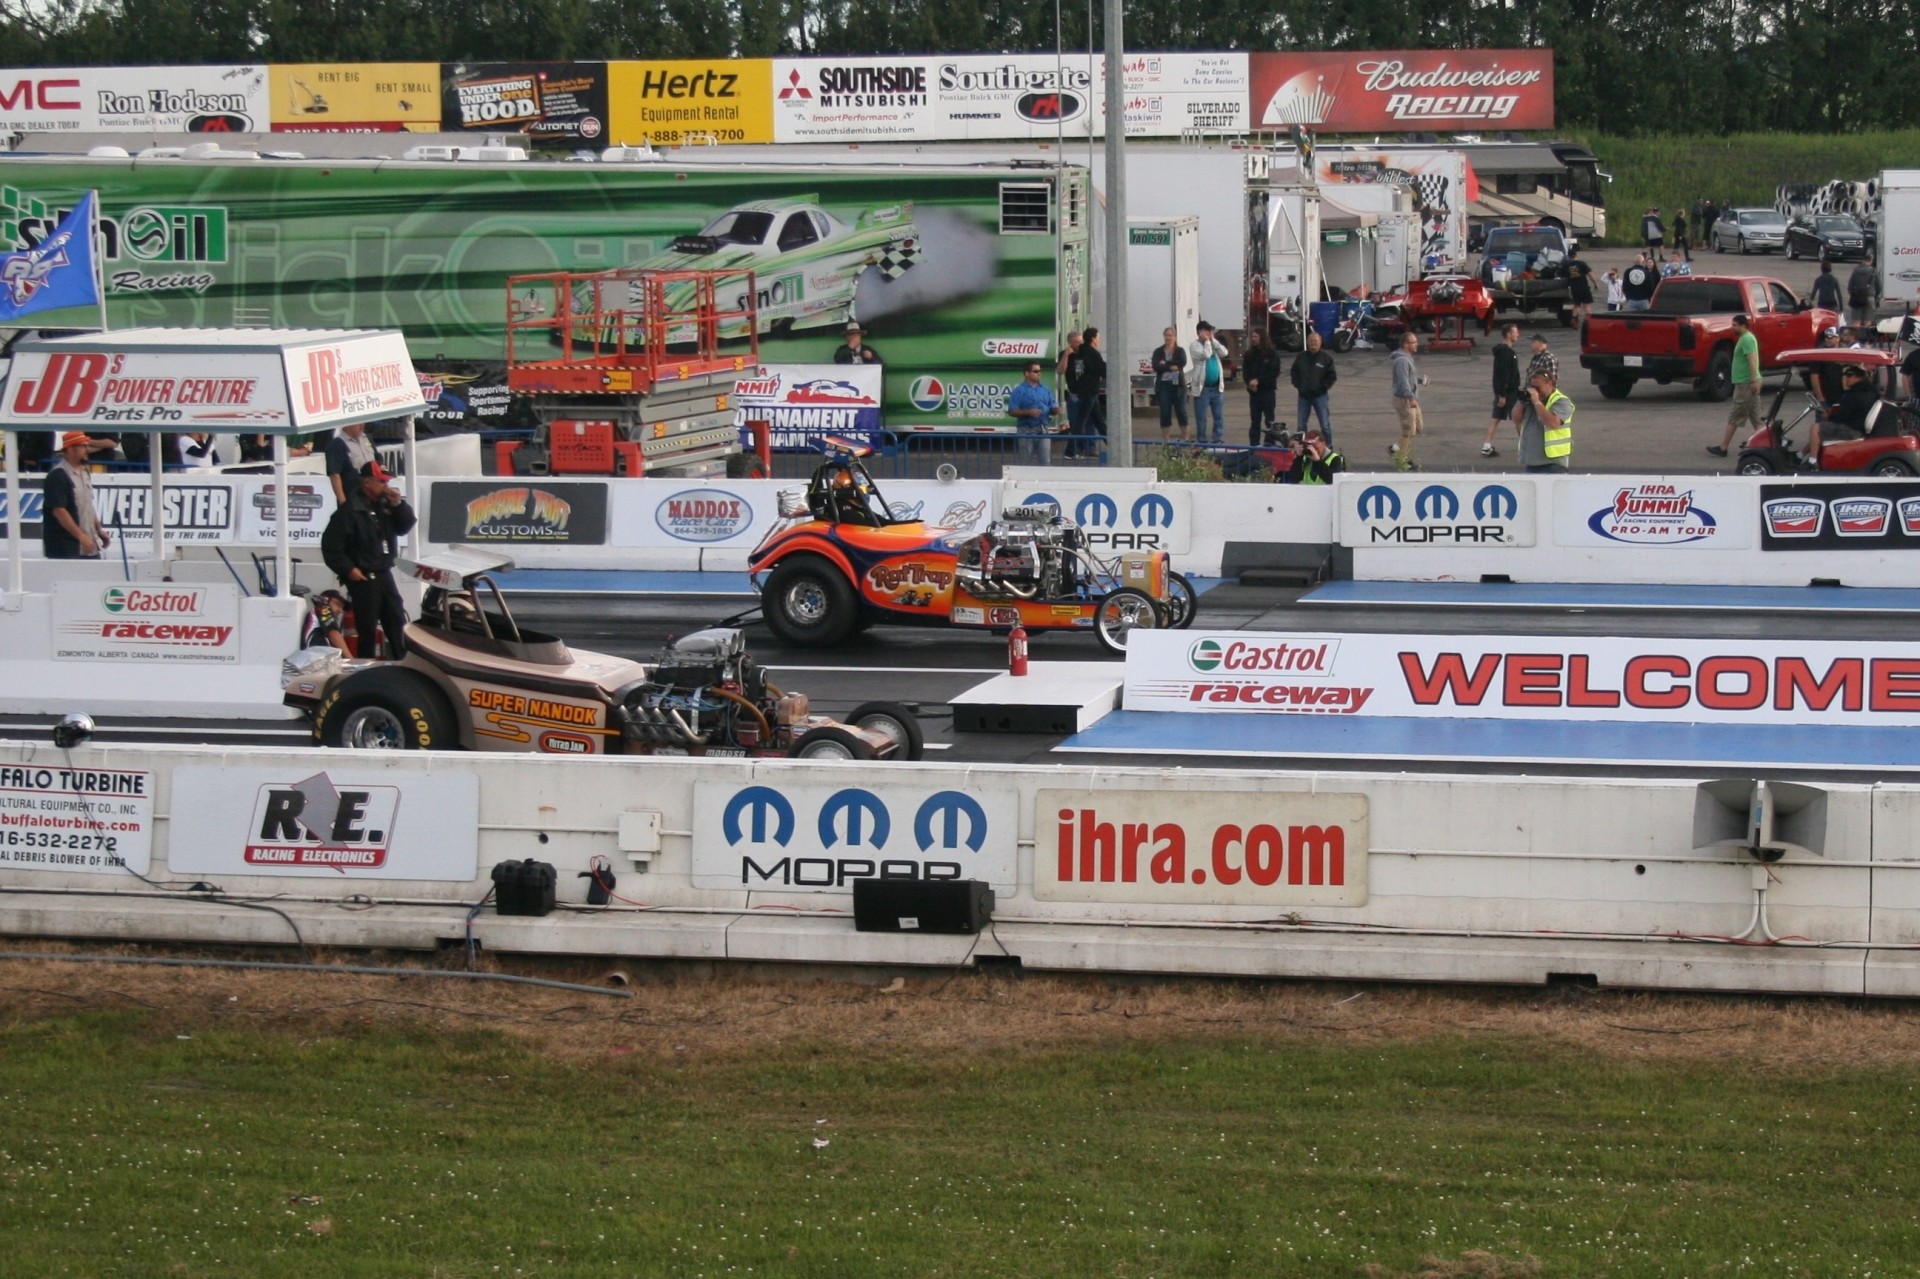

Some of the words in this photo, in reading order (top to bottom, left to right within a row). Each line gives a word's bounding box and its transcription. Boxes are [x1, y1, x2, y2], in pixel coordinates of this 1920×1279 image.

[318, 72, 341, 83] RENT
[344, 73, 360, 82] BIG
[641, 70, 739, 98] Hertz
[819, 66, 926, 95] SOUTHSIDE
[939, 64, 1090, 92] Southgate
[1356, 60, 1541, 92] Budweiser
[375, 83, 398, 93] RENT
[401, 83, 432, 93] SMALL
[458, 80, 532, 96] EVERYTHING
[98, 90, 145, 114] Ron
[148, 88, 247, 114] Hodgson
[460, 93, 501, 106] UNDER
[500, 89, 532, 101] one
[820, 94, 927, 107] MITSUBISHI
[970, 93, 992, 101] Buick
[641, 107, 701, 122] Equipment
[704, 105, 739, 120] Rental
[1186, 102, 1241, 114] SILVERADO
[10, 121, 26, 129] GMC
[29, 121, 55, 129] DEALER
[99, 118, 130, 126] Pontiac
[1193, 116, 1235, 127] SHERIFF
[642, 129, 745, 142] 1-888-7772700
[795, 126, 915, 136] www.southsidemitsubishi.com
[1376, 171, 1416, 185] Wildest
[112, 271, 213, 292] Racing
[997, 341, 1038, 354] Castrol
[339, 367, 371, 397] POWER
[370, 362, 403, 392] CENTRE
[101, 379, 175, 405] POWER
[176, 379, 257, 405] CENTRE
[948, 384, 1013, 396] LANDA
[342, 398, 366, 414] Parts
[366, 395, 381, 411] Pro
[477, 405, 508, 416] Racing!
[948, 398, 1004, 409] SIGNS
[92, 406, 145, 421] Parts
[149, 407, 183, 420] Pro
[429, 411, 464, 419] TOUR
[734, 408, 858, 428] OURNAMENT
[1640, 485, 1676, 495] IHRA
[667, 500, 741, 518] MADDOX
[1772, 505, 1815, 513] IHRA
[1840, 504, 1883, 513] IHRA
[668, 516, 703, 526] Race
[704, 515, 739, 527] Cars
[178, 531, 195, 540] THE
[197, 531, 221, 540] IHRA
[1370, 525, 1505, 543] MOPAR
[1610, 526, 1670, 535] PRO-AM
[1676, 527, 1716, 535] TOUR
[870, 565, 910, 591] Rat
[908, 563, 953, 591] Trap
[126, 590, 199, 613] Castrol
[101, 623, 234, 647] raceway
[57, 650, 95, 658] EDMONTON
[1223, 641, 1329, 671] Castrol
[1396, 651, 1920, 712] WELCOME
[469, 688, 527, 716] SUPER
[1189, 684, 1375, 714] raceway
[59, 771, 144, 794] TURBINE
[40, 801, 96, 813] EQUIPMENT
[119, 804, 139, 815] INC.
[1057, 808, 1346, 886] ihra.com
[14, 851, 46, 862] DEBRIS
[49, 854, 87, 865] BLOWER
[89, 856, 102, 866] OF
[104, 857, 126, 867] IHRA
[252, 848, 297, 861] RACING
[301, 849, 376, 864] ELECTRONICS
[741, 856, 962, 886] MOPAR
